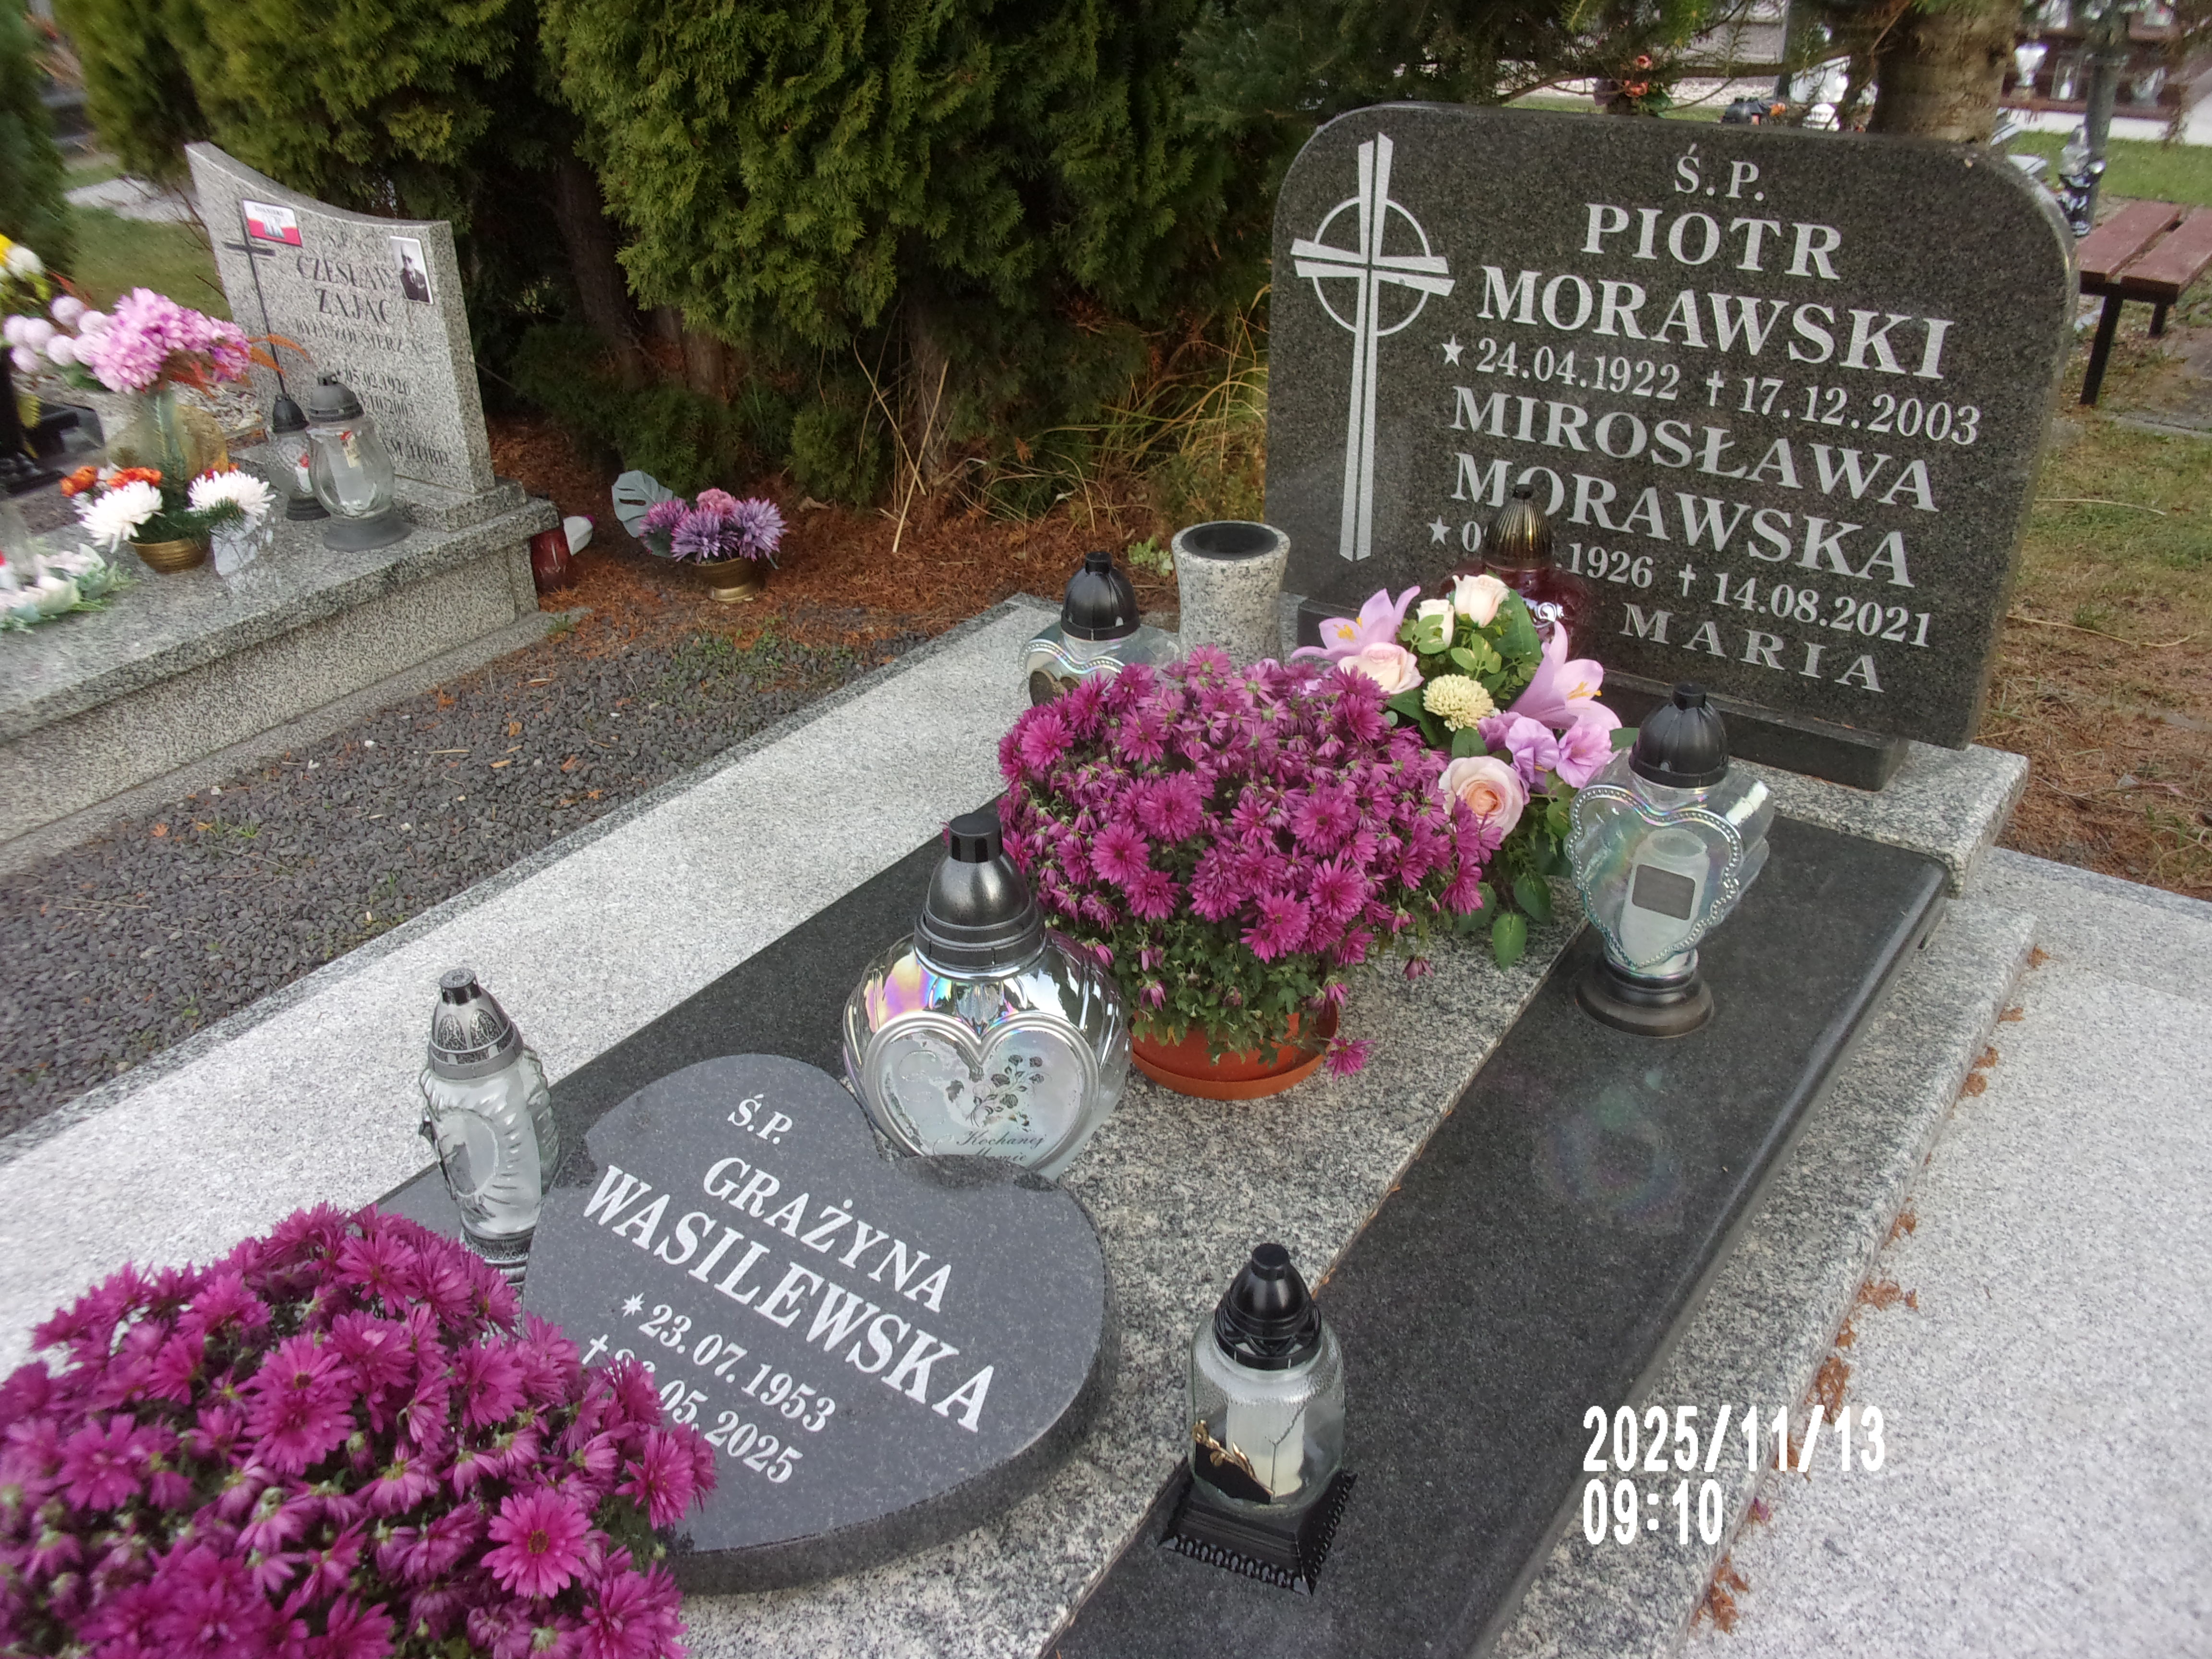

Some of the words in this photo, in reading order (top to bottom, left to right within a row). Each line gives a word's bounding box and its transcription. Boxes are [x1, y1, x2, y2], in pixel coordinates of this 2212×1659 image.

[1581, 204, 1840, 280] PIOTR
[1477, 265, 1954, 379] MORAWSKI
[1476, 337, 1680, 400] 24.04.1922
[1739, 377, 1980, 445] 17.12.2003
[1450, 386, 1939, 512] MIROSŁAWA
[1623, 603, 1884, 693] MARIA
[1712, 573, 1930, 647] 14.08.2021
[703, 1157, 952, 1313] GRAŻYNA
[583, 1165, 994, 1432] WASILEWSKA
[638, 1304, 836, 1432] 23.07.1953
